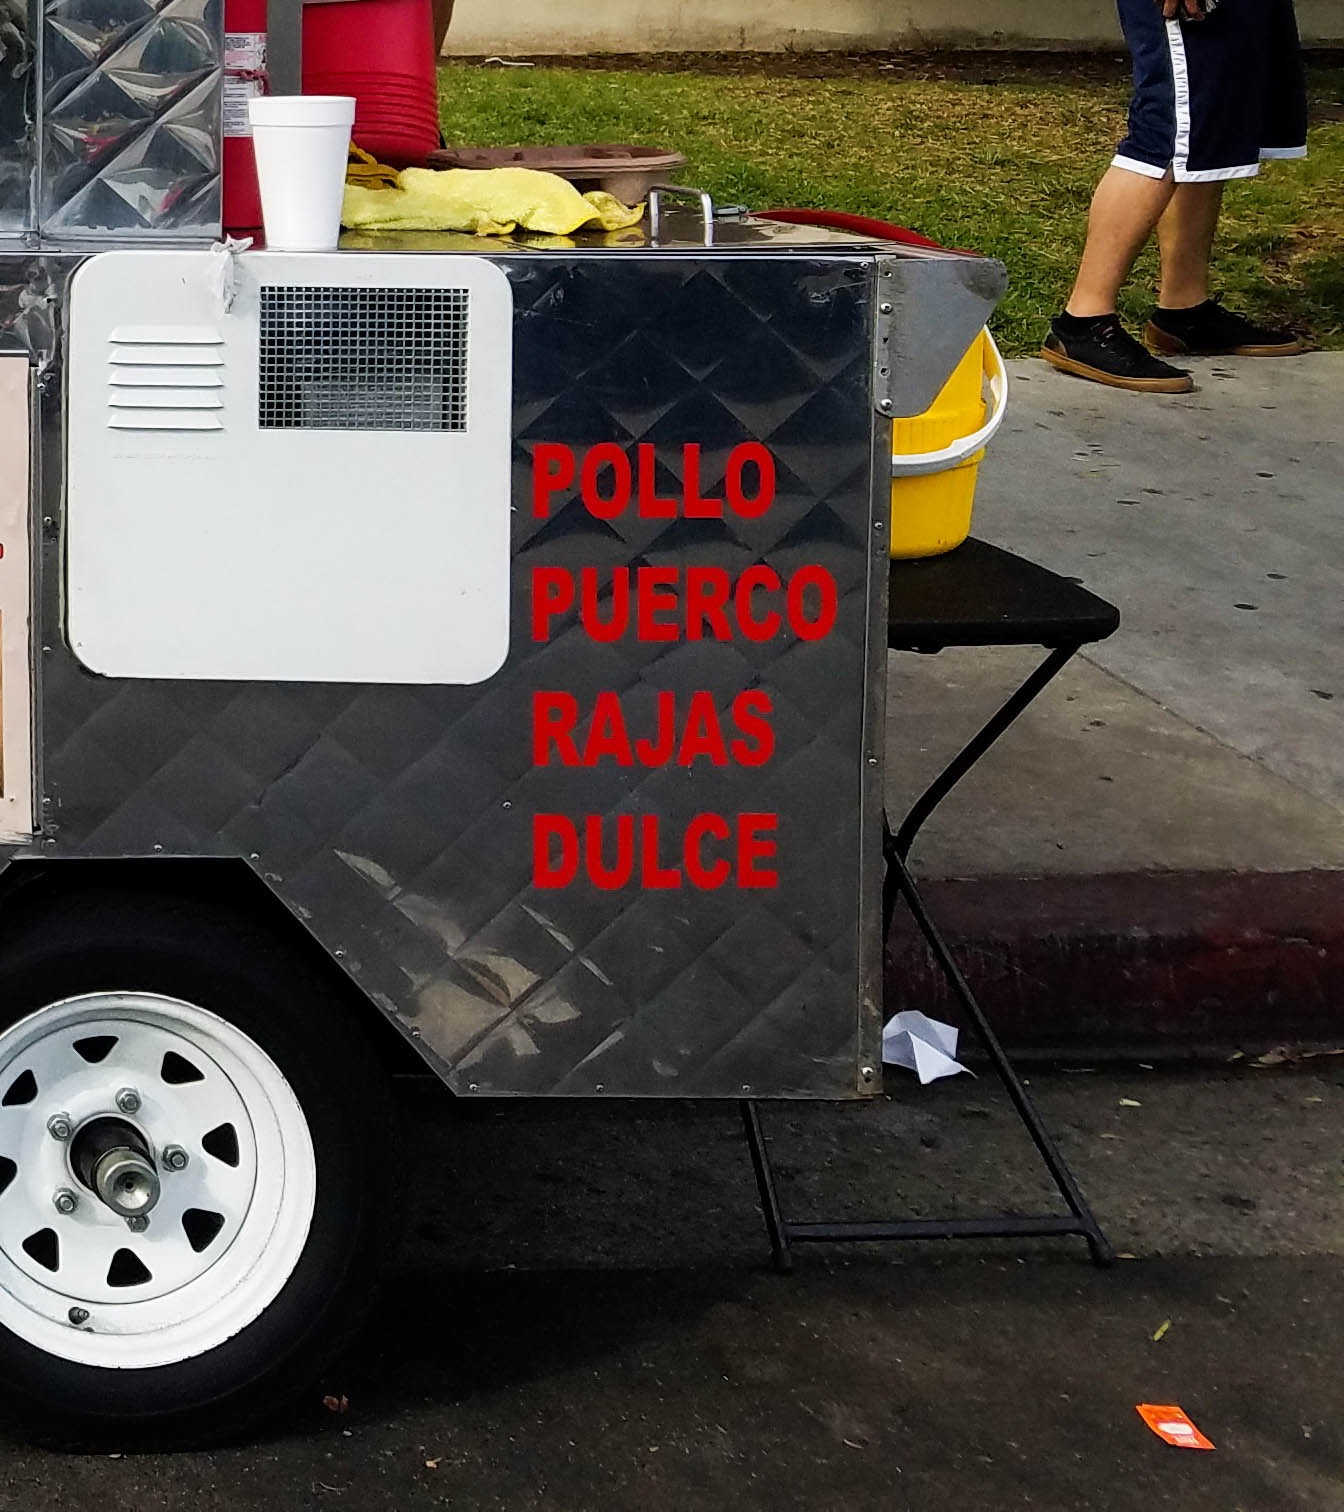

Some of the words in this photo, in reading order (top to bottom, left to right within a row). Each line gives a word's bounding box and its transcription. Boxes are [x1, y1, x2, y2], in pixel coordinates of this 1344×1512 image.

[532, 441, 776, 521] POLLO
[531, 564, 838, 643] PUERCO
[532, 689, 775, 768] RAJAS
[532, 812, 778, 891] DULCE
